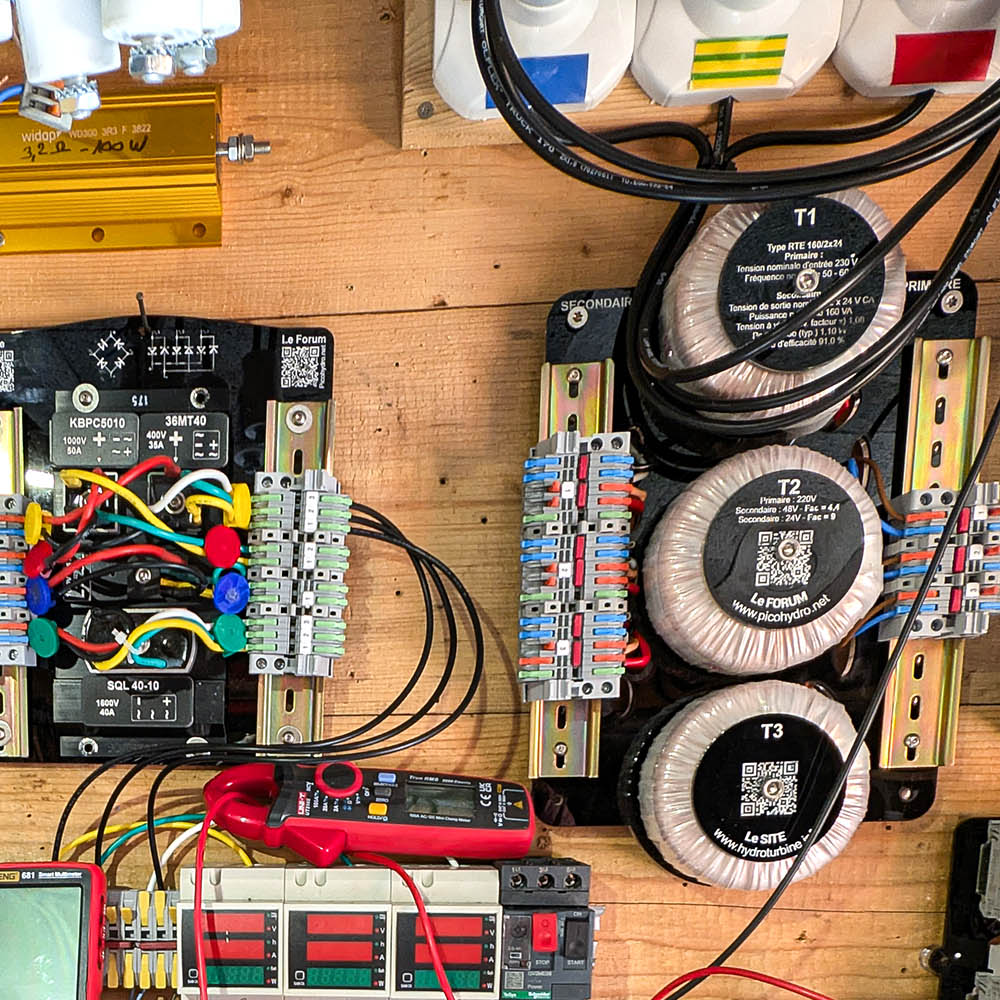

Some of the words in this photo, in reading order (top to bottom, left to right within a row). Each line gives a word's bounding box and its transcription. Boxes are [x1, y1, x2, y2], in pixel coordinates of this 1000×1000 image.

[506, 100, 534, 135] TRUCK
[101, 126, 118, 137] 3R3
[129, 135, 149, 153] W
[794, 207, 817, 226] T1
[767, 243, 787, 253] Type
[788, 241, 806, 251] RTE
[807, 239, 843, 250] 160/2x24
[784, 251, 818, 261] Primaire
[736, 264, 766, 274] Tension
[766, 262, 801, 272] nominale
[802, 259, 834, 270] d'entrée
[835, 258, 850, 267] 230
[822, 269, 832, 278] 50
[728, 303, 758, 313] Tension
[759, 302, 769, 311] de
[770, 301, 791, 311] sortie
[842, 297, 853, 306] 24
[854, 296, 862, 305] V
[749, 311, 788, 321] Puissance
[825, 307, 840, 317] 160
[841, 306, 853, 315] VA
[736, 322, 765, 331] Tension
[810, 318, 837, 327] facteur
[281, 333, 294, 345] Le
[296, 333, 327, 345] Forum
[777, 338, 818, 348] d'efficacité
[69, 417, 126, 429] KBPC5010
[165, 415, 207, 427] 36MT40
[63, 436, 87, 445] 1000V
[146, 430, 167, 440] 400V
[67, 446, 82, 455] 50A
[148, 440, 165, 450] 35A
[777, 478, 801, 495] T2
[760, 496, 791, 505] Primaire
[796, 495, 817, 503] 220V
[735, 506, 777, 515] Secondaire
[782, 505, 798, 513] 48V
[804, 504, 820, 512] Fac
[738, 515, 780, 524] Secondaire
[785, 514, 802, 523] 24V
[807, 513, 822, 521] Fac
[830, 513, 836, 521] 9
[750, 591, 764, 607] Le
[765, 591, 809, 609] FORUM
[732, 593, 831, 624] www.picohydro.net
[107, 680, 130, 691] SQL
[131, 680, 160, 691] 40-10
[99, 708, 116, 717] 40A
[760, 722, 784, 740] T3
[744, 830, 759, 843] Le
[760, 830, 787, 845] SITE
[21, 871, 35, 880] 681
